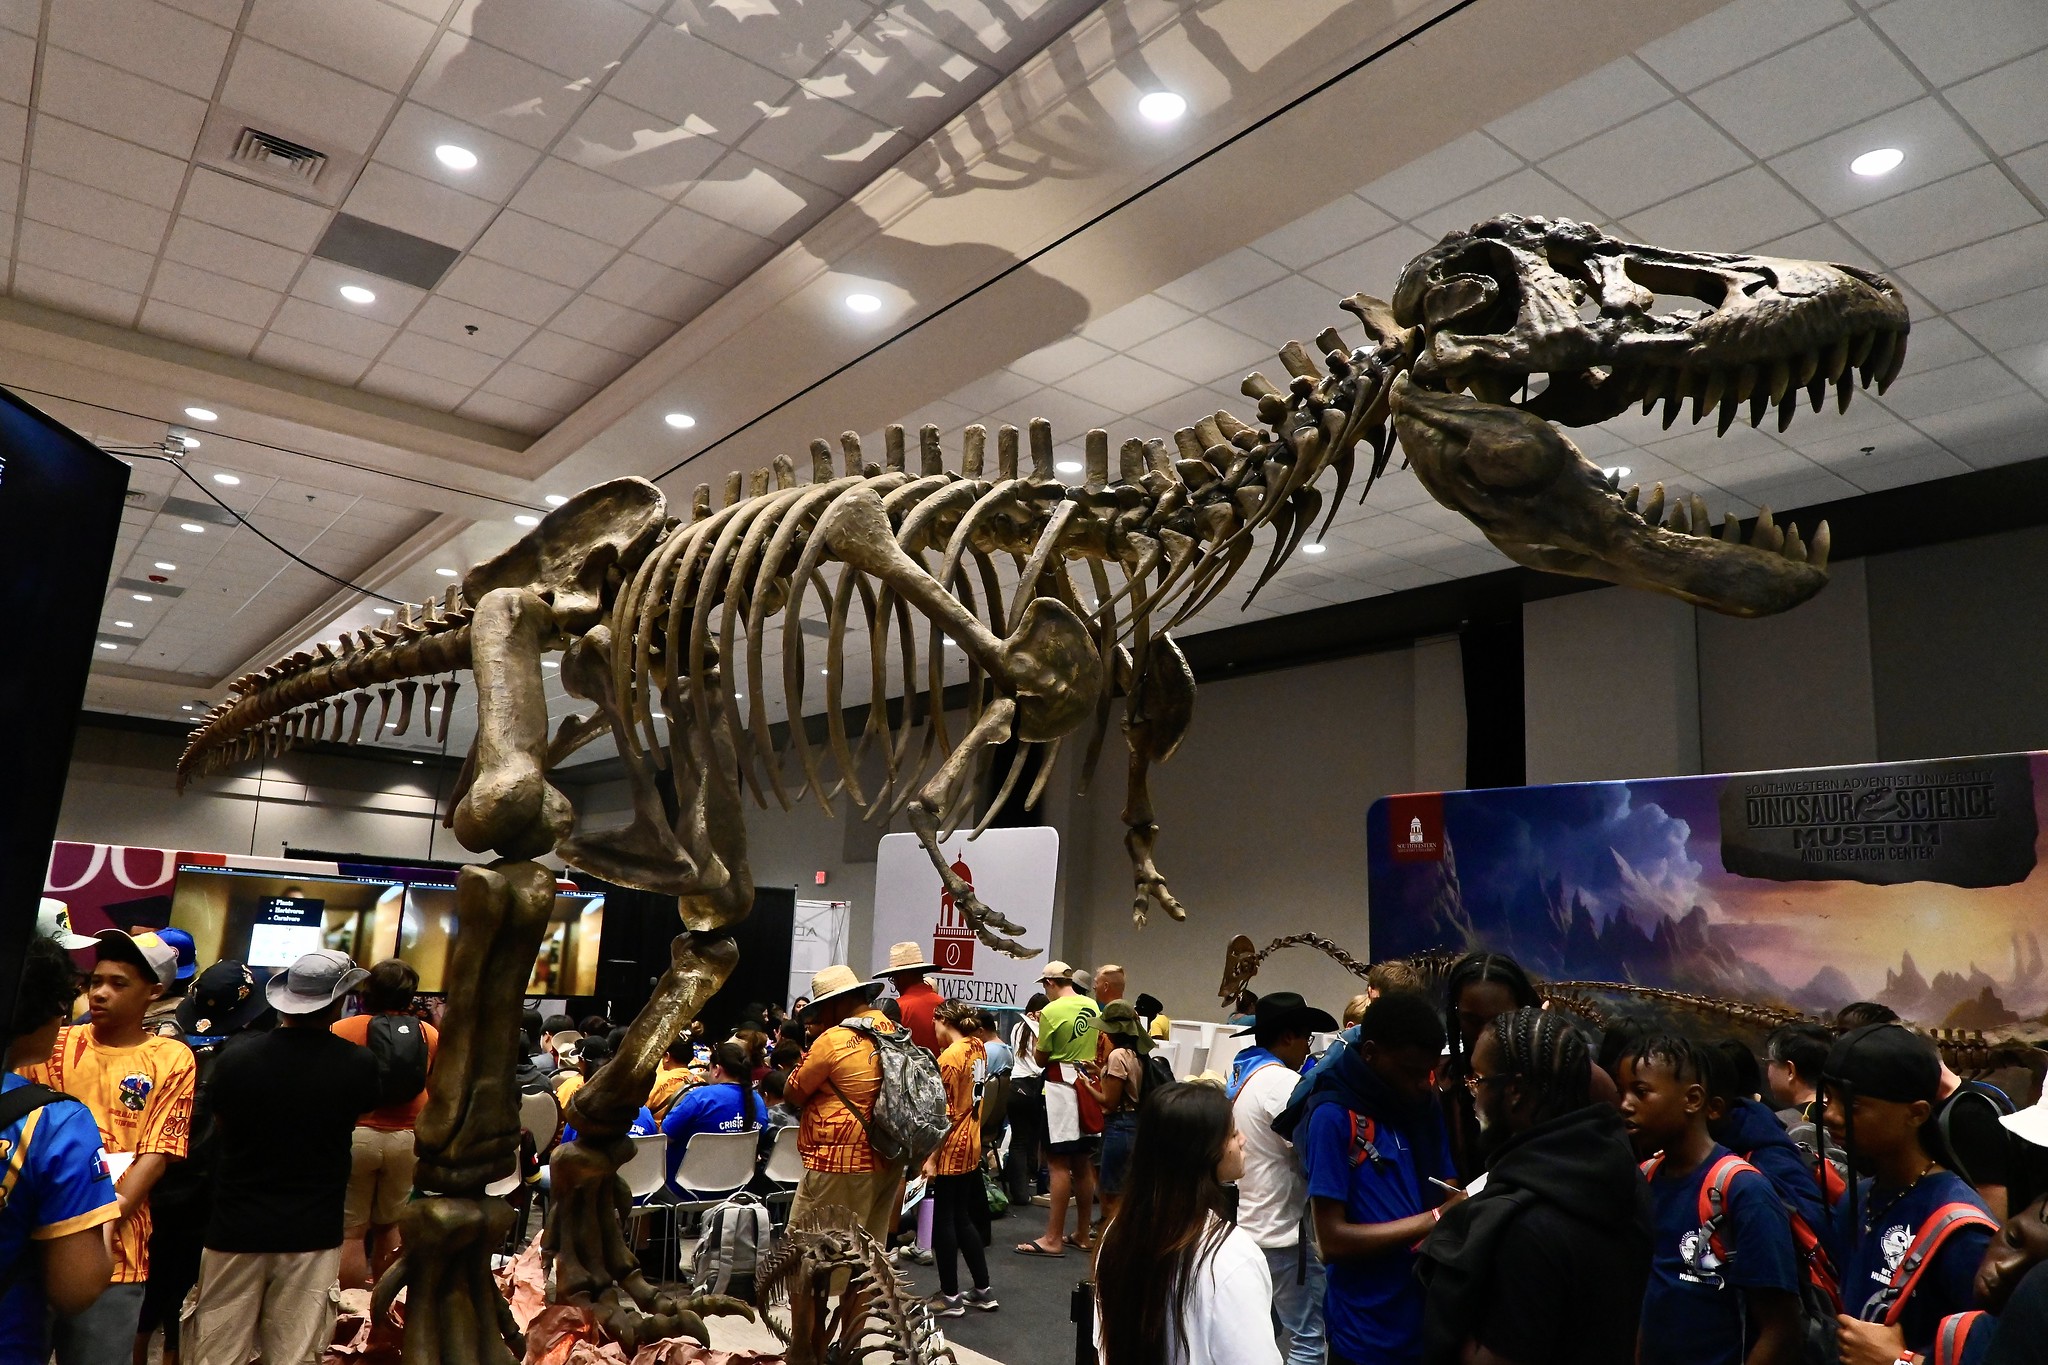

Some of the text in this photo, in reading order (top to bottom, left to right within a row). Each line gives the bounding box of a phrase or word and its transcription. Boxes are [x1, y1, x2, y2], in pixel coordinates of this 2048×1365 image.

[1745, 770, 1993, 795] SOUTHWESTERN ADVENTIST UNIVERSITY
[1746, 785, 1996, 826] DINOSAUR SCIENCE
[1793, 823, 1941, 849] MUSEUM
[1801, 845, 1935, 862] AND RESEARCH CENTER
